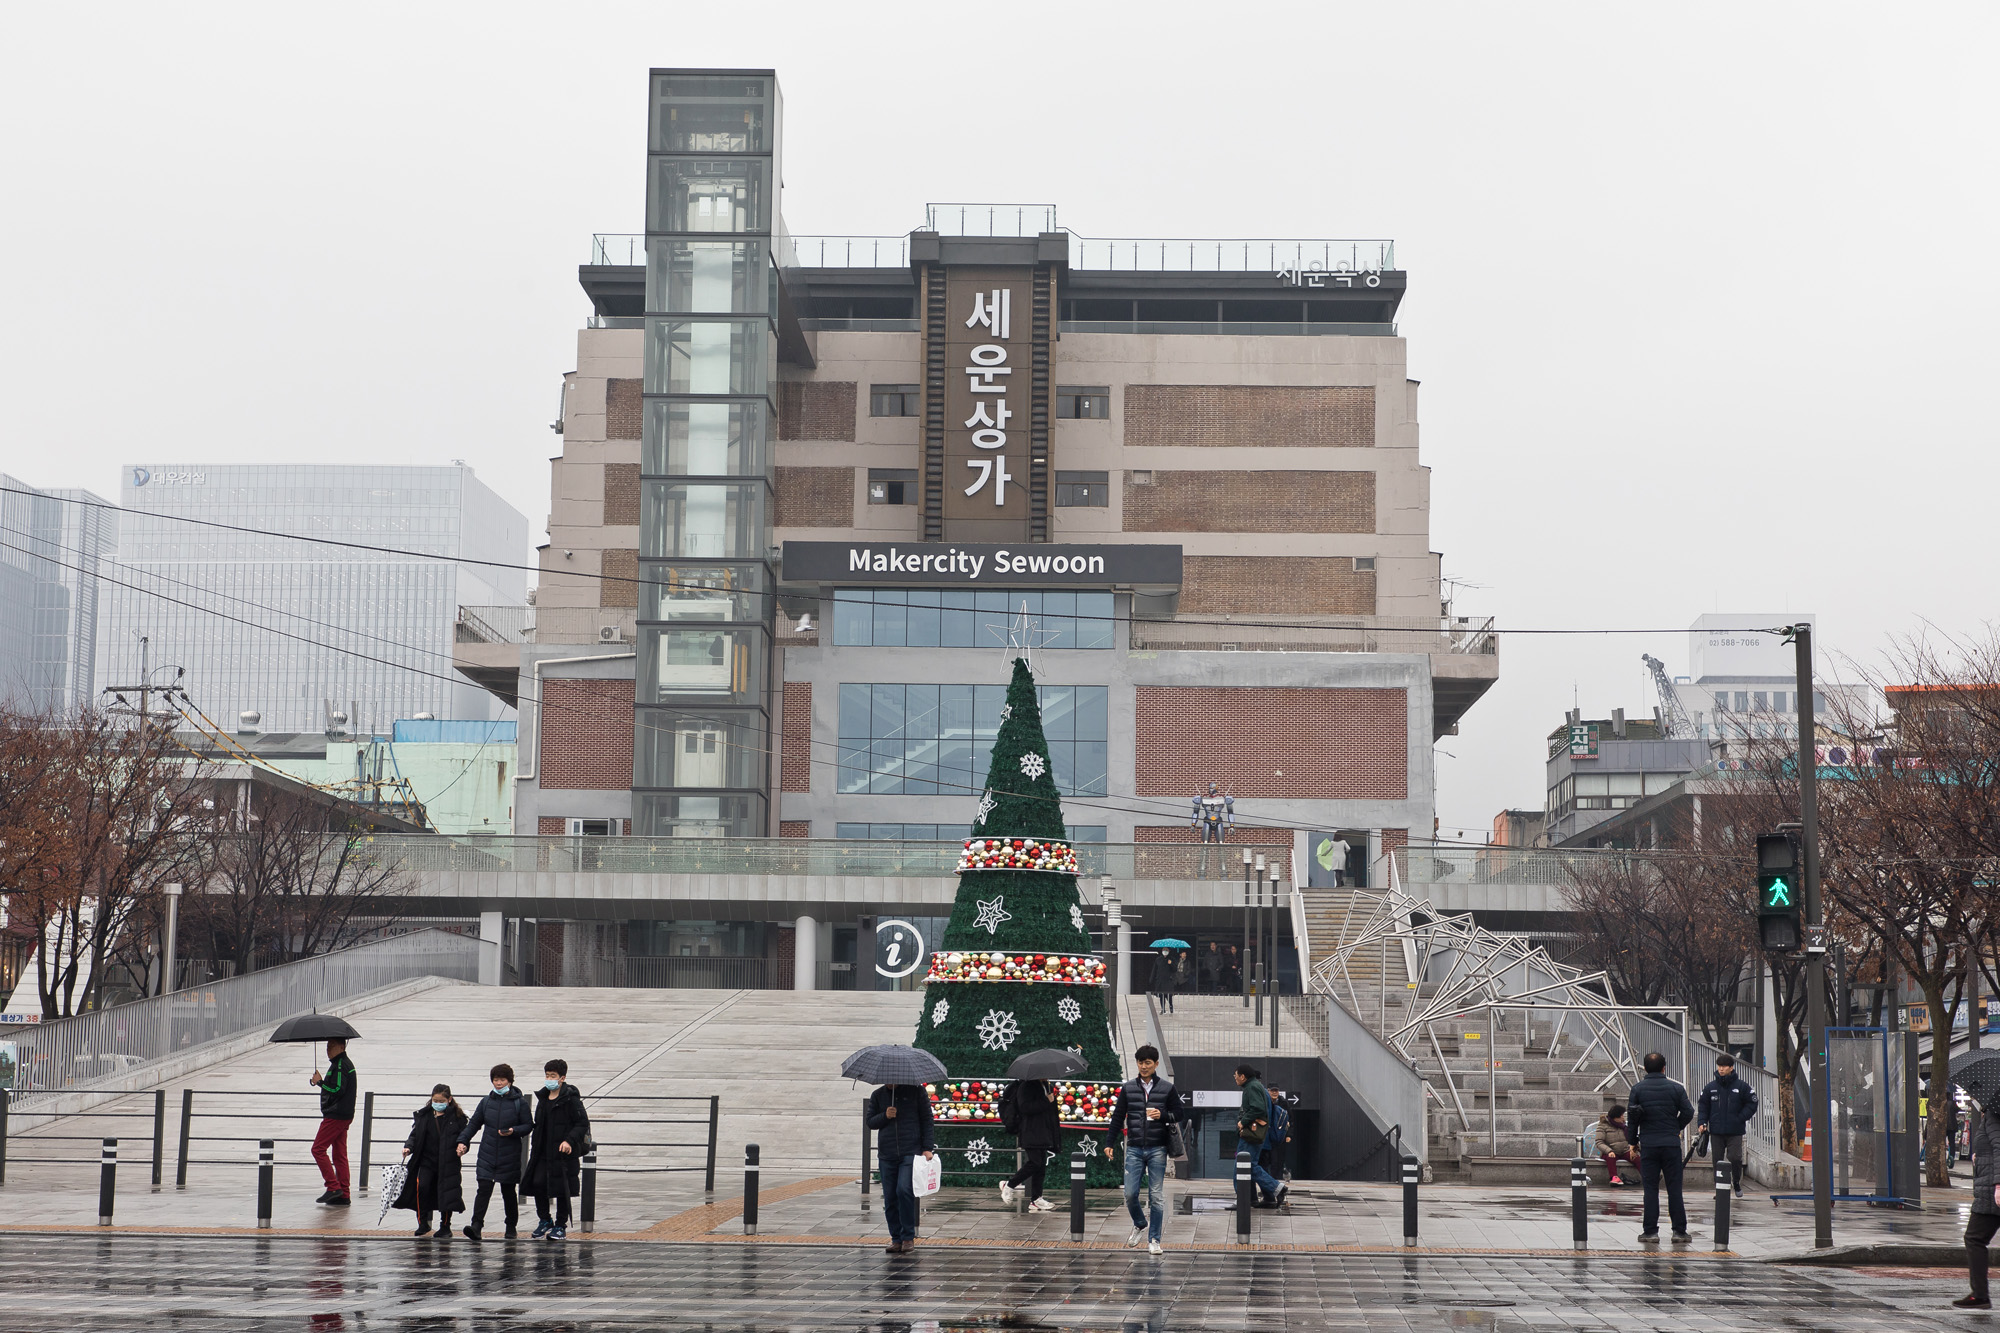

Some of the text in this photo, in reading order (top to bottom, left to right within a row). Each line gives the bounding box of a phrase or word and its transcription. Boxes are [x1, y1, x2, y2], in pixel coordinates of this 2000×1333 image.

[1276, 259, 1384, 288] 세운옥상
[964, 288, 1012, 506] 세운상가
[153, 471, 206, 485] 대우건설
[849, 548, 1105, 579] Makercity Sewoon
[1721, 639, 1760, 647] 588-7066
